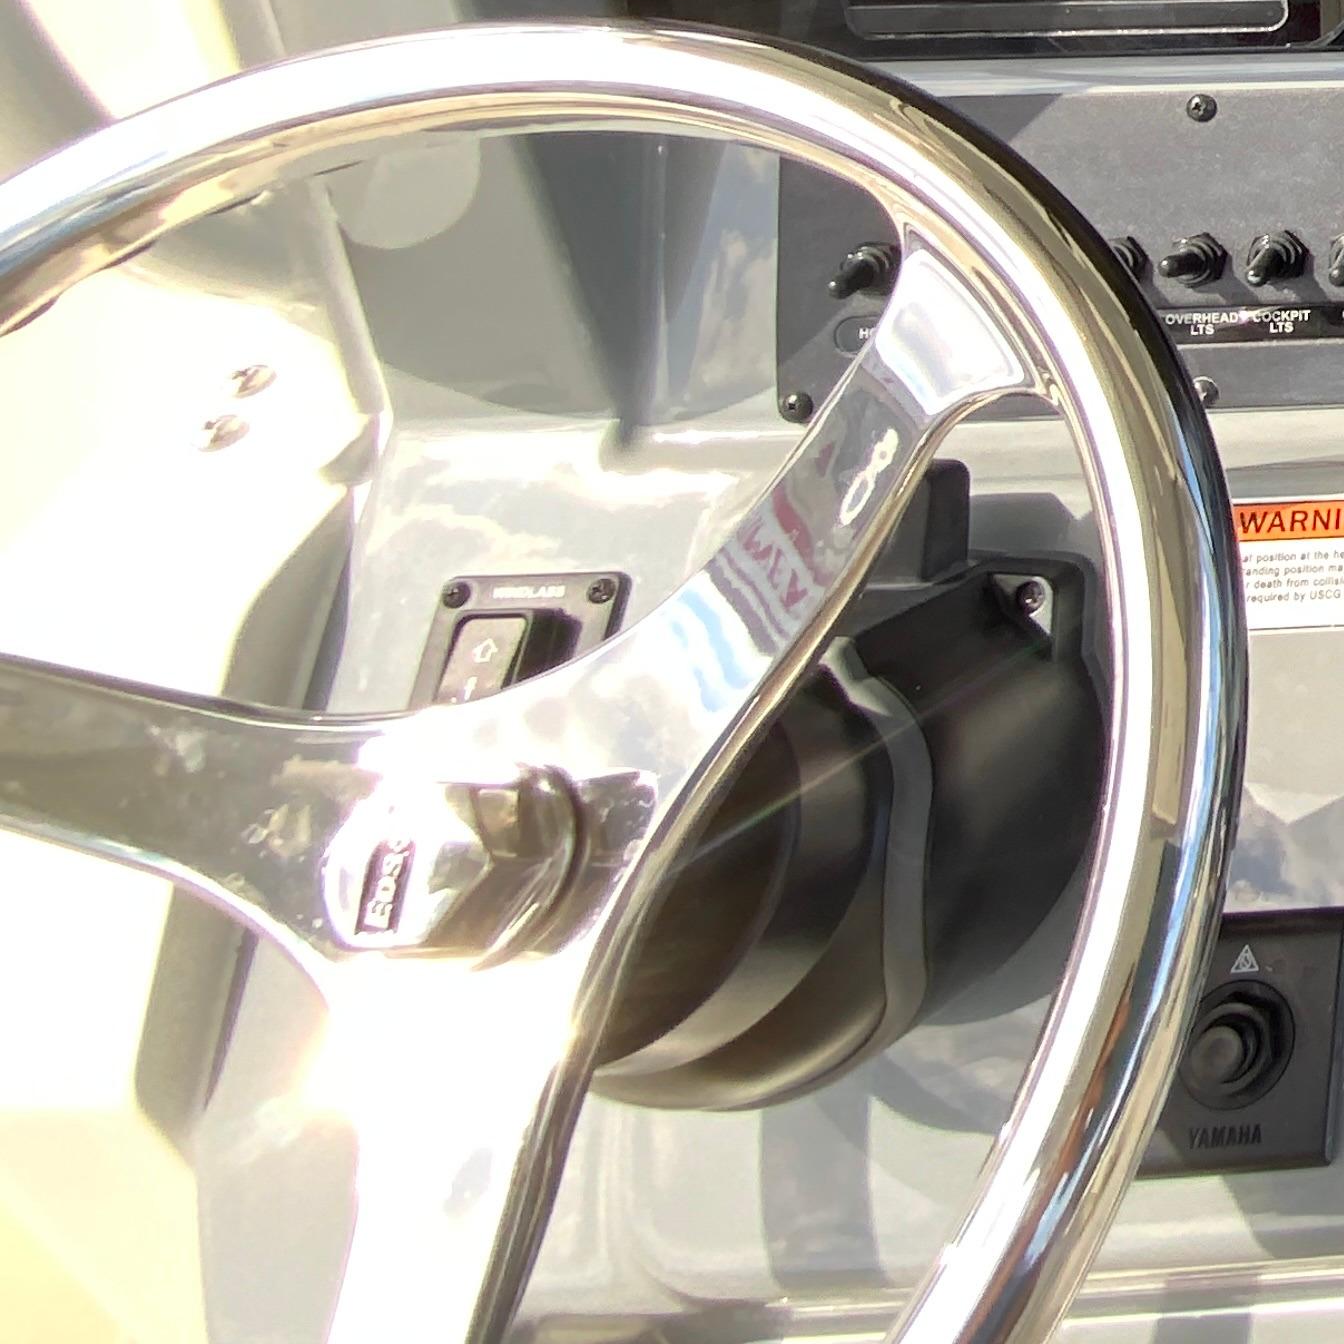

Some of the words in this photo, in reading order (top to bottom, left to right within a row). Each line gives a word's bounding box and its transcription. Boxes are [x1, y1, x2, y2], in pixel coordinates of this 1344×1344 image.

[1165, 311, 1239, 325] OVERHEAD
[1252, 310, 1311, 322] COCKPIT
[1190, 324, 1214, 335] LTS
[1269, 321, 1294, 333] LTS
[1257, 553, 1296, 564] position
[1314, 550, 1329, 560] the
[1284, 564, 1324, 576] position
[1254, 578, 1282, 589] death
[1286, 577, 1309, 588] from
[1246, 591, 1290, 603] required
[1294, 591, 1306, 603] by
[1309, 588, 1341, 600] USCG
[1188, 1123, 1262, 1149] YAMAHA
